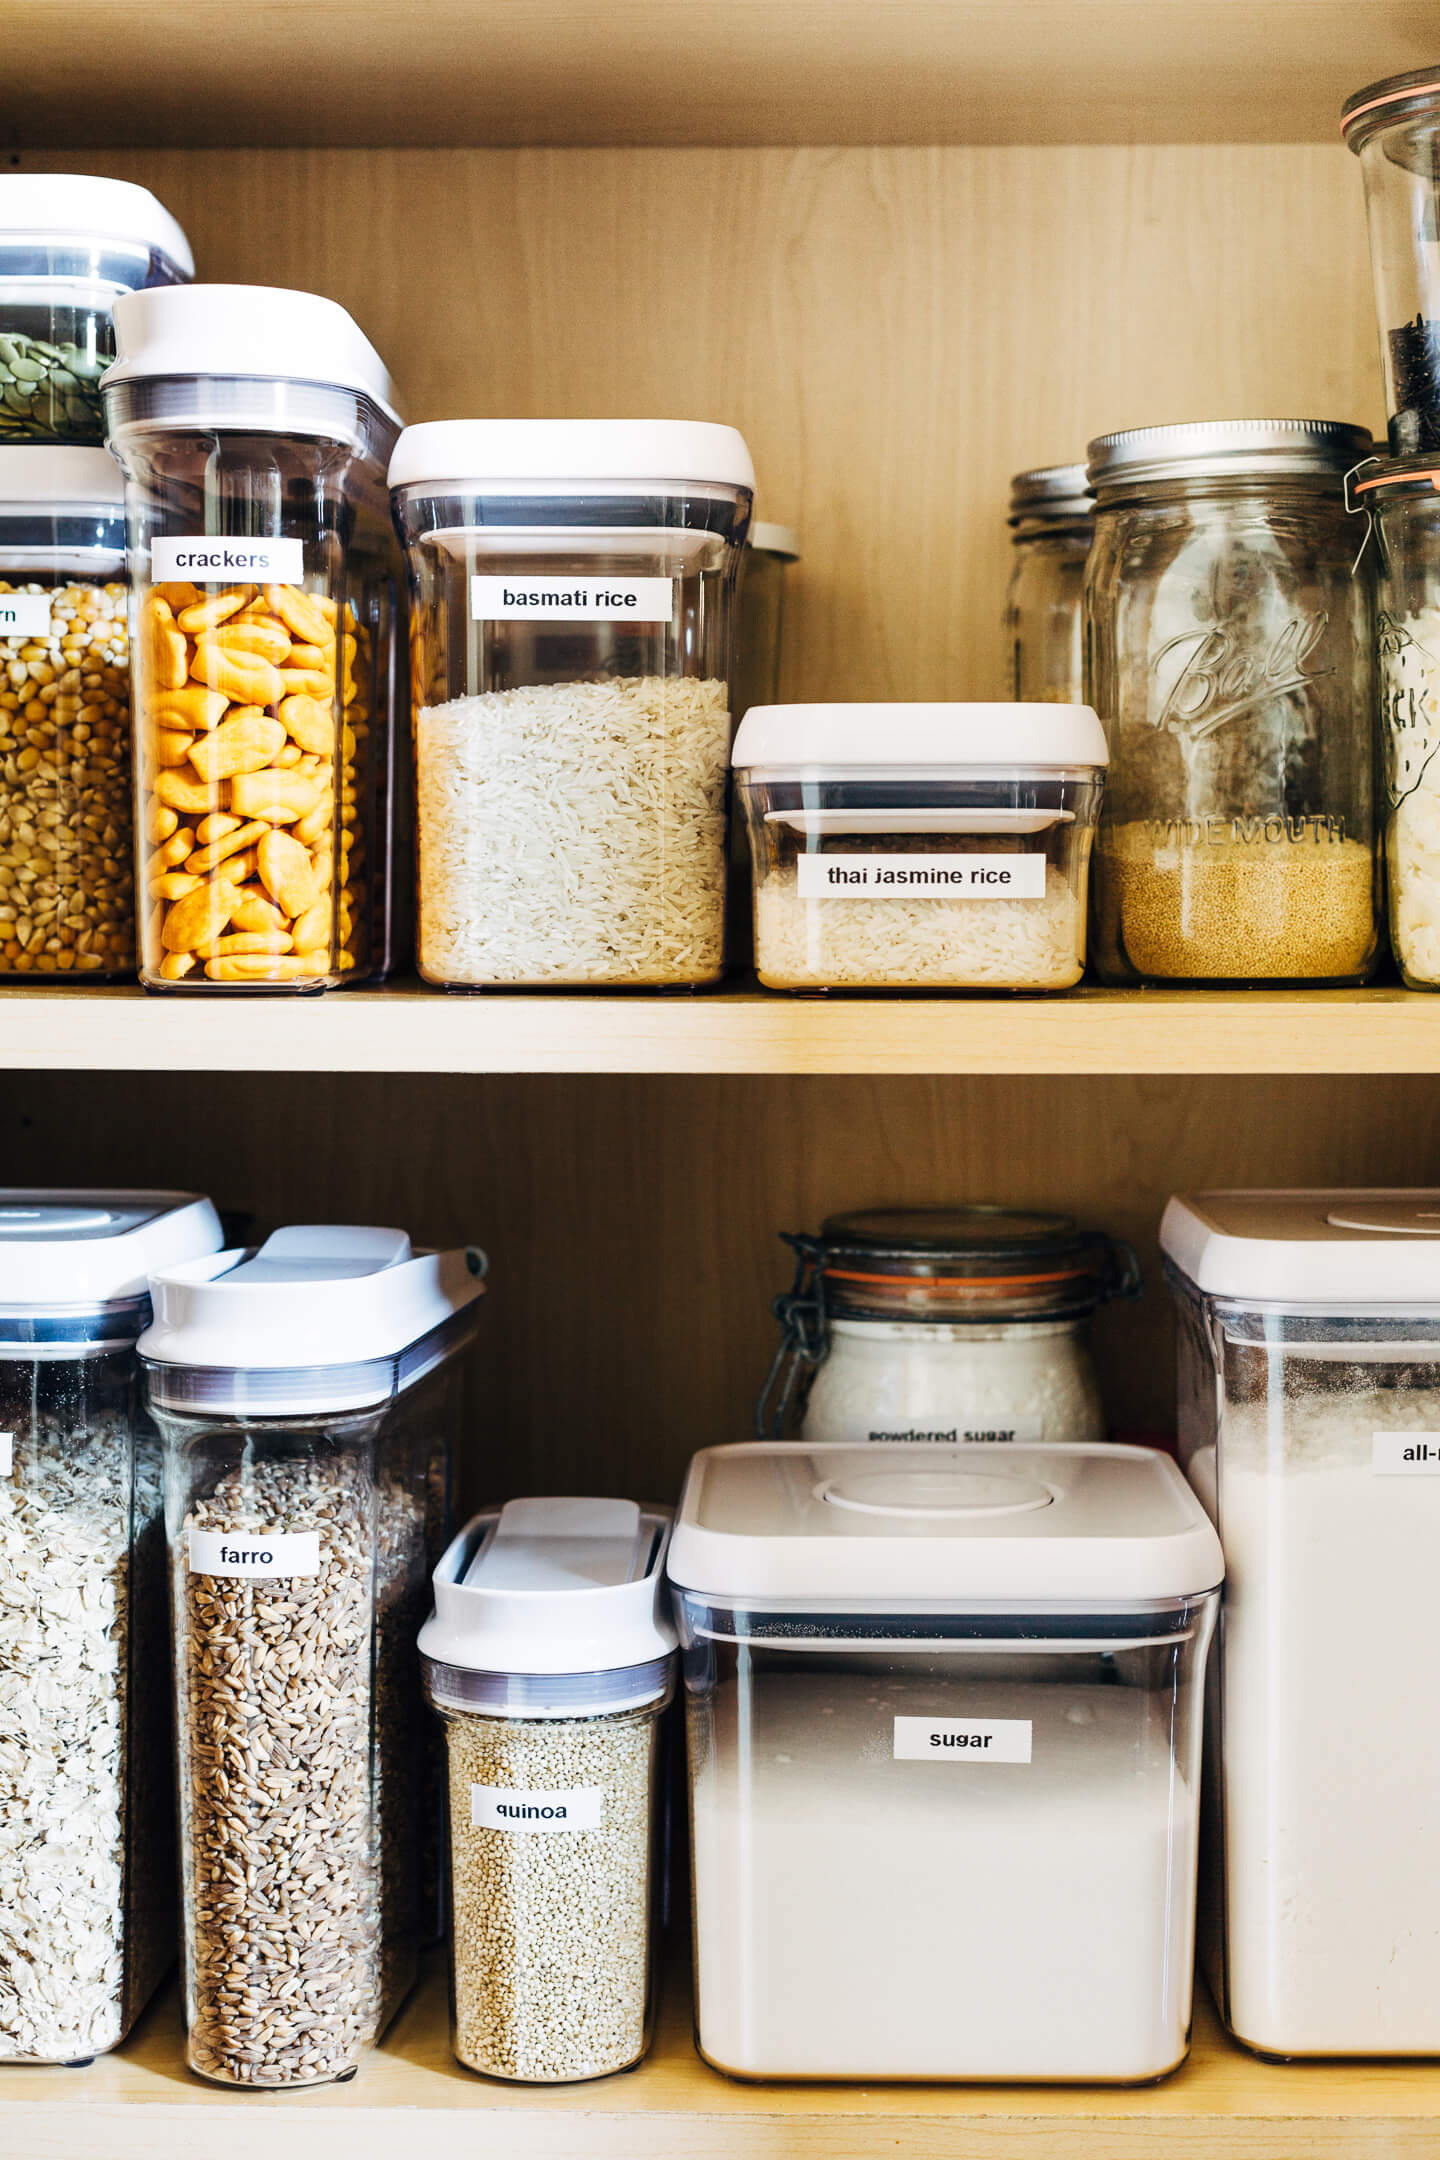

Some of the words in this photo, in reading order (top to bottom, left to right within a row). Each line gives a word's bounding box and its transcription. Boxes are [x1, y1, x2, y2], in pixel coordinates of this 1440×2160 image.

[176, 550, 270, 568] crackers
[503, 589, 588, 607] basmati
[595, 591, 637, 607] rice
[1152, 611, 1337, 732] Ball
[1232, 814, 1345, 845] MOUTH
[827, 867, 868, 884] thai
[874, 868, 963, 884] jasmine
[970, 868, 1012, 884] rice
[868, 1429, 958, 1442] powdered
[963, 1430, 1016, 1442] sugar
[1403, 1444, 1440, 1461] all-
[220, 1546, 273, 1564] farro
[929, 1733, 993, 1748] sugar
[496, 1803, 567, 1819] quinoa
